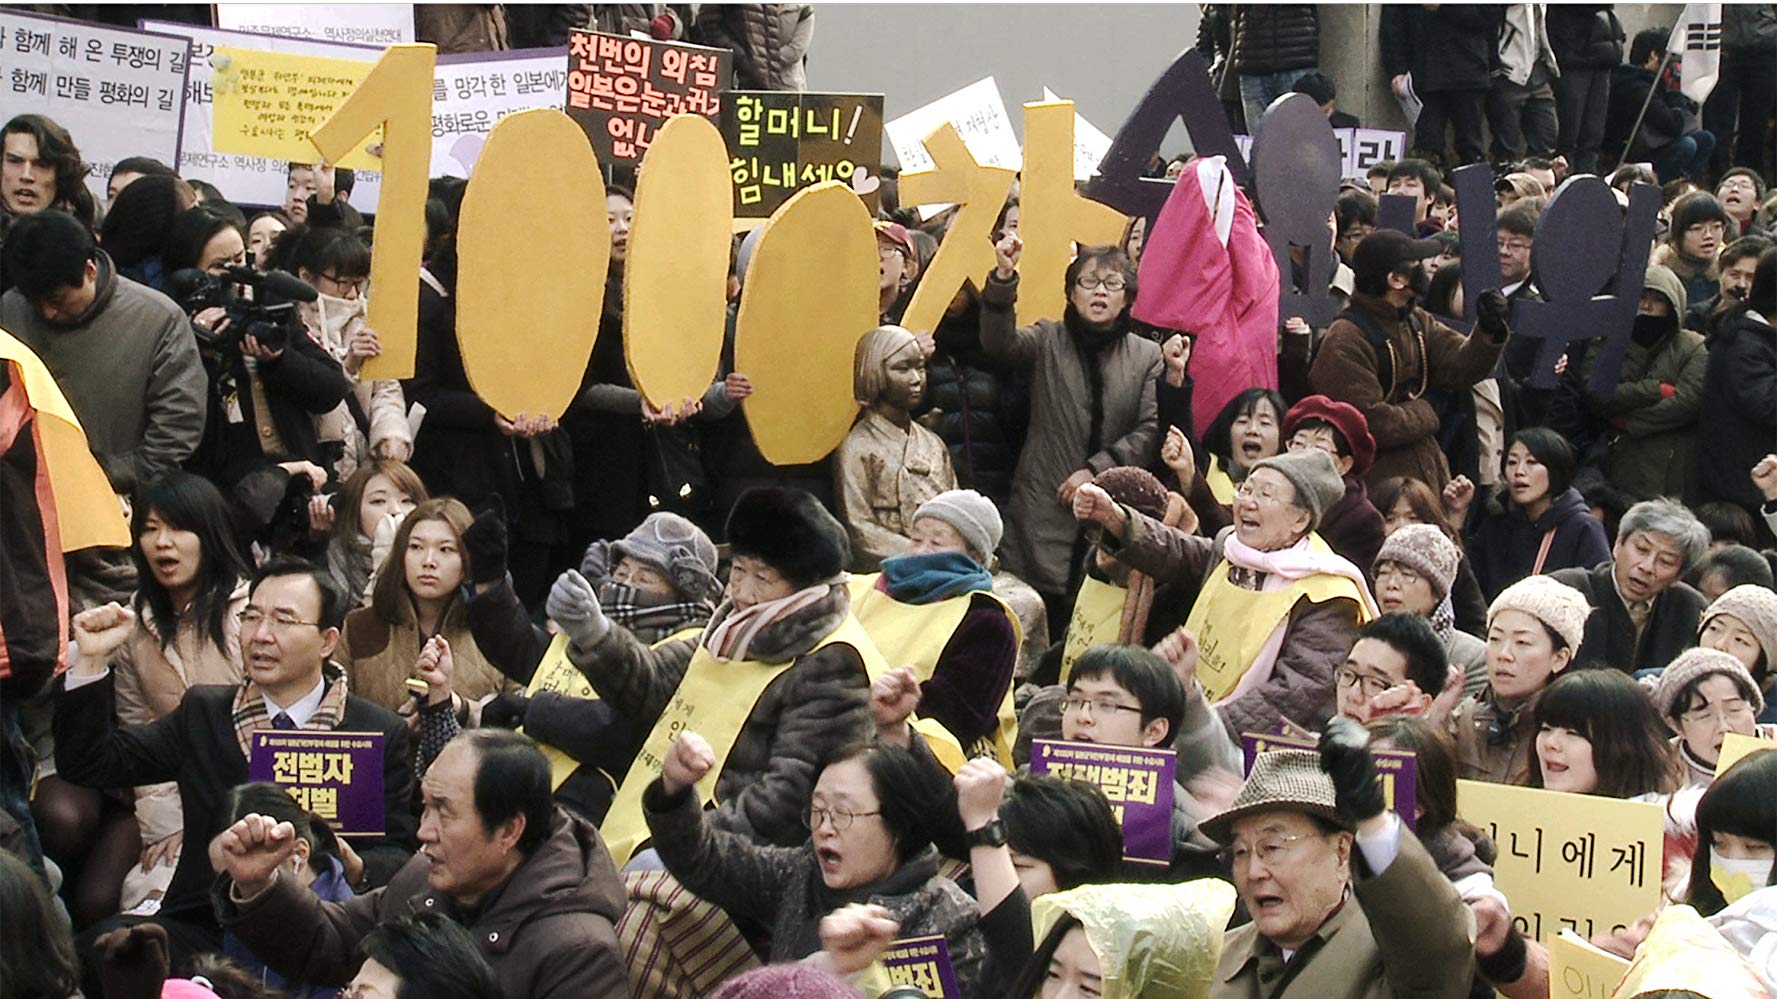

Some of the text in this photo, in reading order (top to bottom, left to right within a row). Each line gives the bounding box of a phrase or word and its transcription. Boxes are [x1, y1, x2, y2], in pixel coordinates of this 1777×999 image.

[15, 28, 51, 56] 함께
[59, 36, 78, 60] 해
[85, 39, 103, 63] 온
[110, 43, 161, 71] 투쟁의
[169, 51, 186, 75] 길
[570, 32, 718, 87] 천번의 외침
[11, 68, 48, 96] 함께
[56, 75, 92, 101] 만들
[100, 81, 149, 108] 평화의
[156, 89, 174, 111] 길
[431, 110, 492, 138] 평화로운
[736, 94, 864, 146] 할머니!
[273, 751, 354, 785] 전범자
[1481, 822, 1645, 888] 니에게
